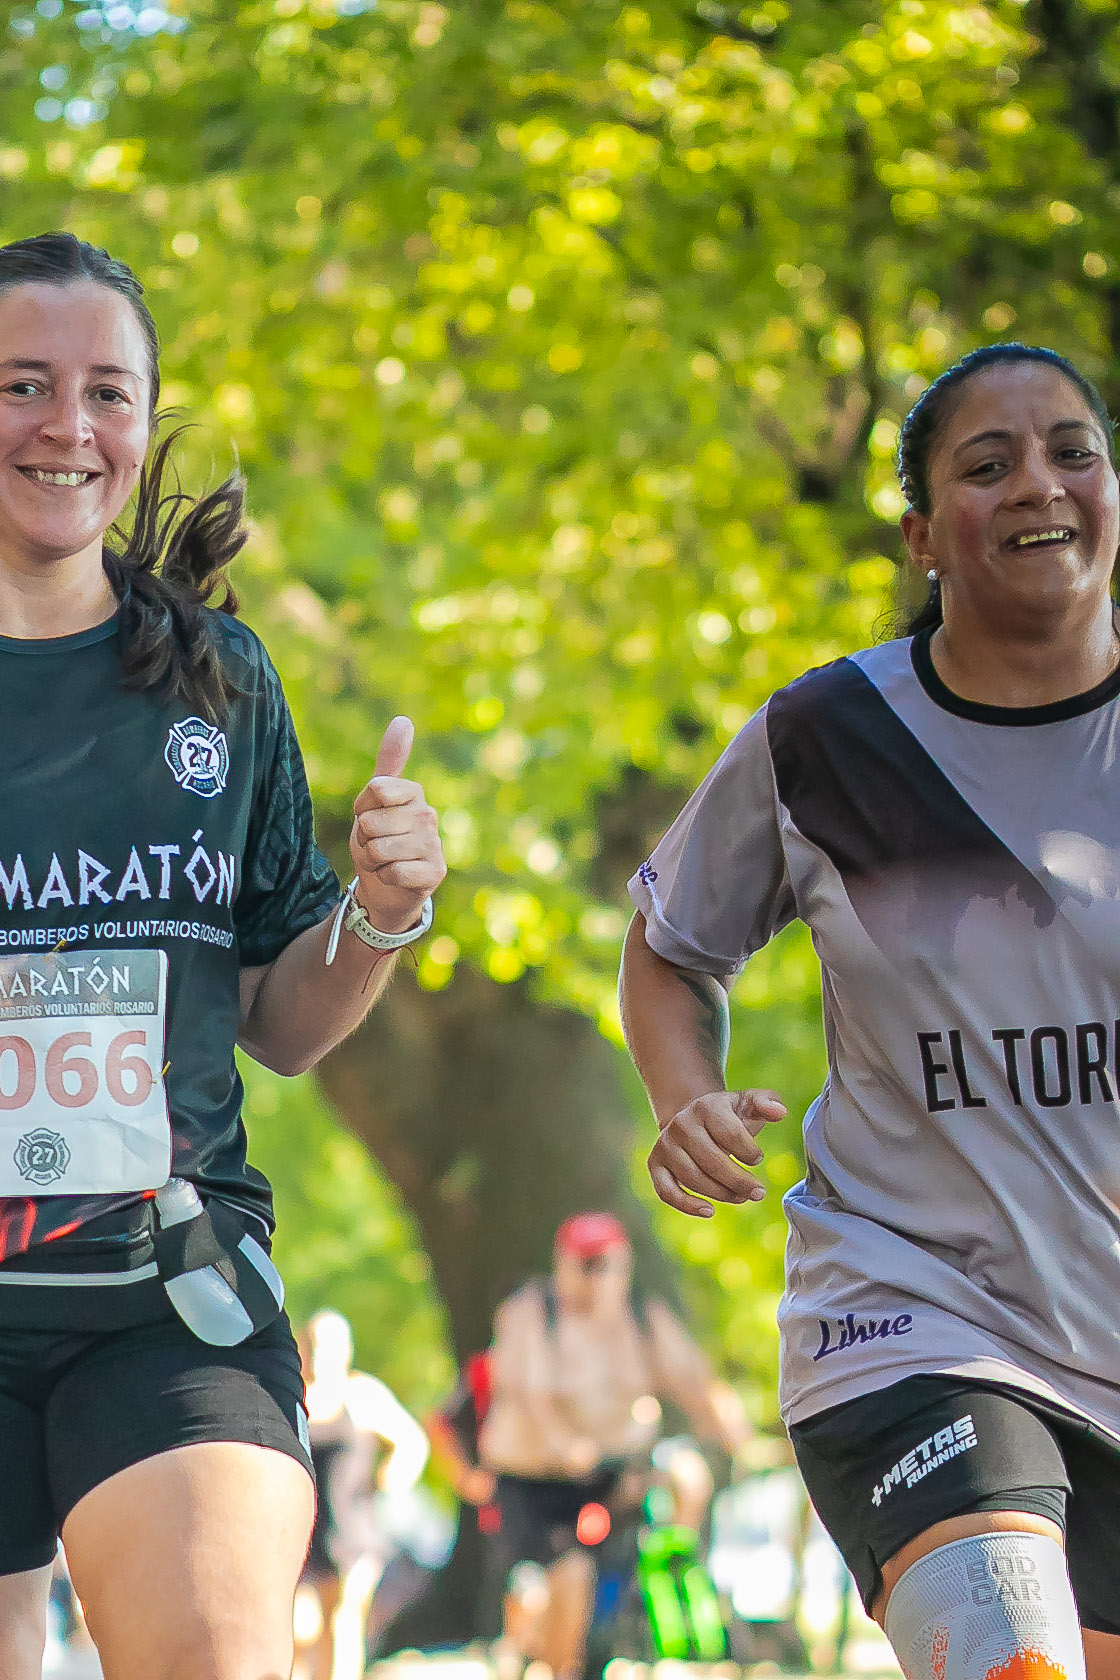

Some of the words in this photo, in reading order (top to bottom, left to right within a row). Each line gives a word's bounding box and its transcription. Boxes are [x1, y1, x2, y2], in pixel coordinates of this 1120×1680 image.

[187, 742, 212, 768] 27
[93, 919, 201, 939] VOLUNTARIOS
[44, 1001, 112, 1016] VOLUNTARIOS
[113, 1001, 155, 1014] ROSARIO
[916, 1029, 988, 1114] EL
[991, 1018, 1120, 1108] TOR
[32, 1145, 54, 1165] 27
[812, 1313, 913, 1362] Lihue
[906, 1433, 978, 1489] RUNNING
[965, 1556, 1037, 1583] BOD
[970, 1577, 1043, 1607] CAR
